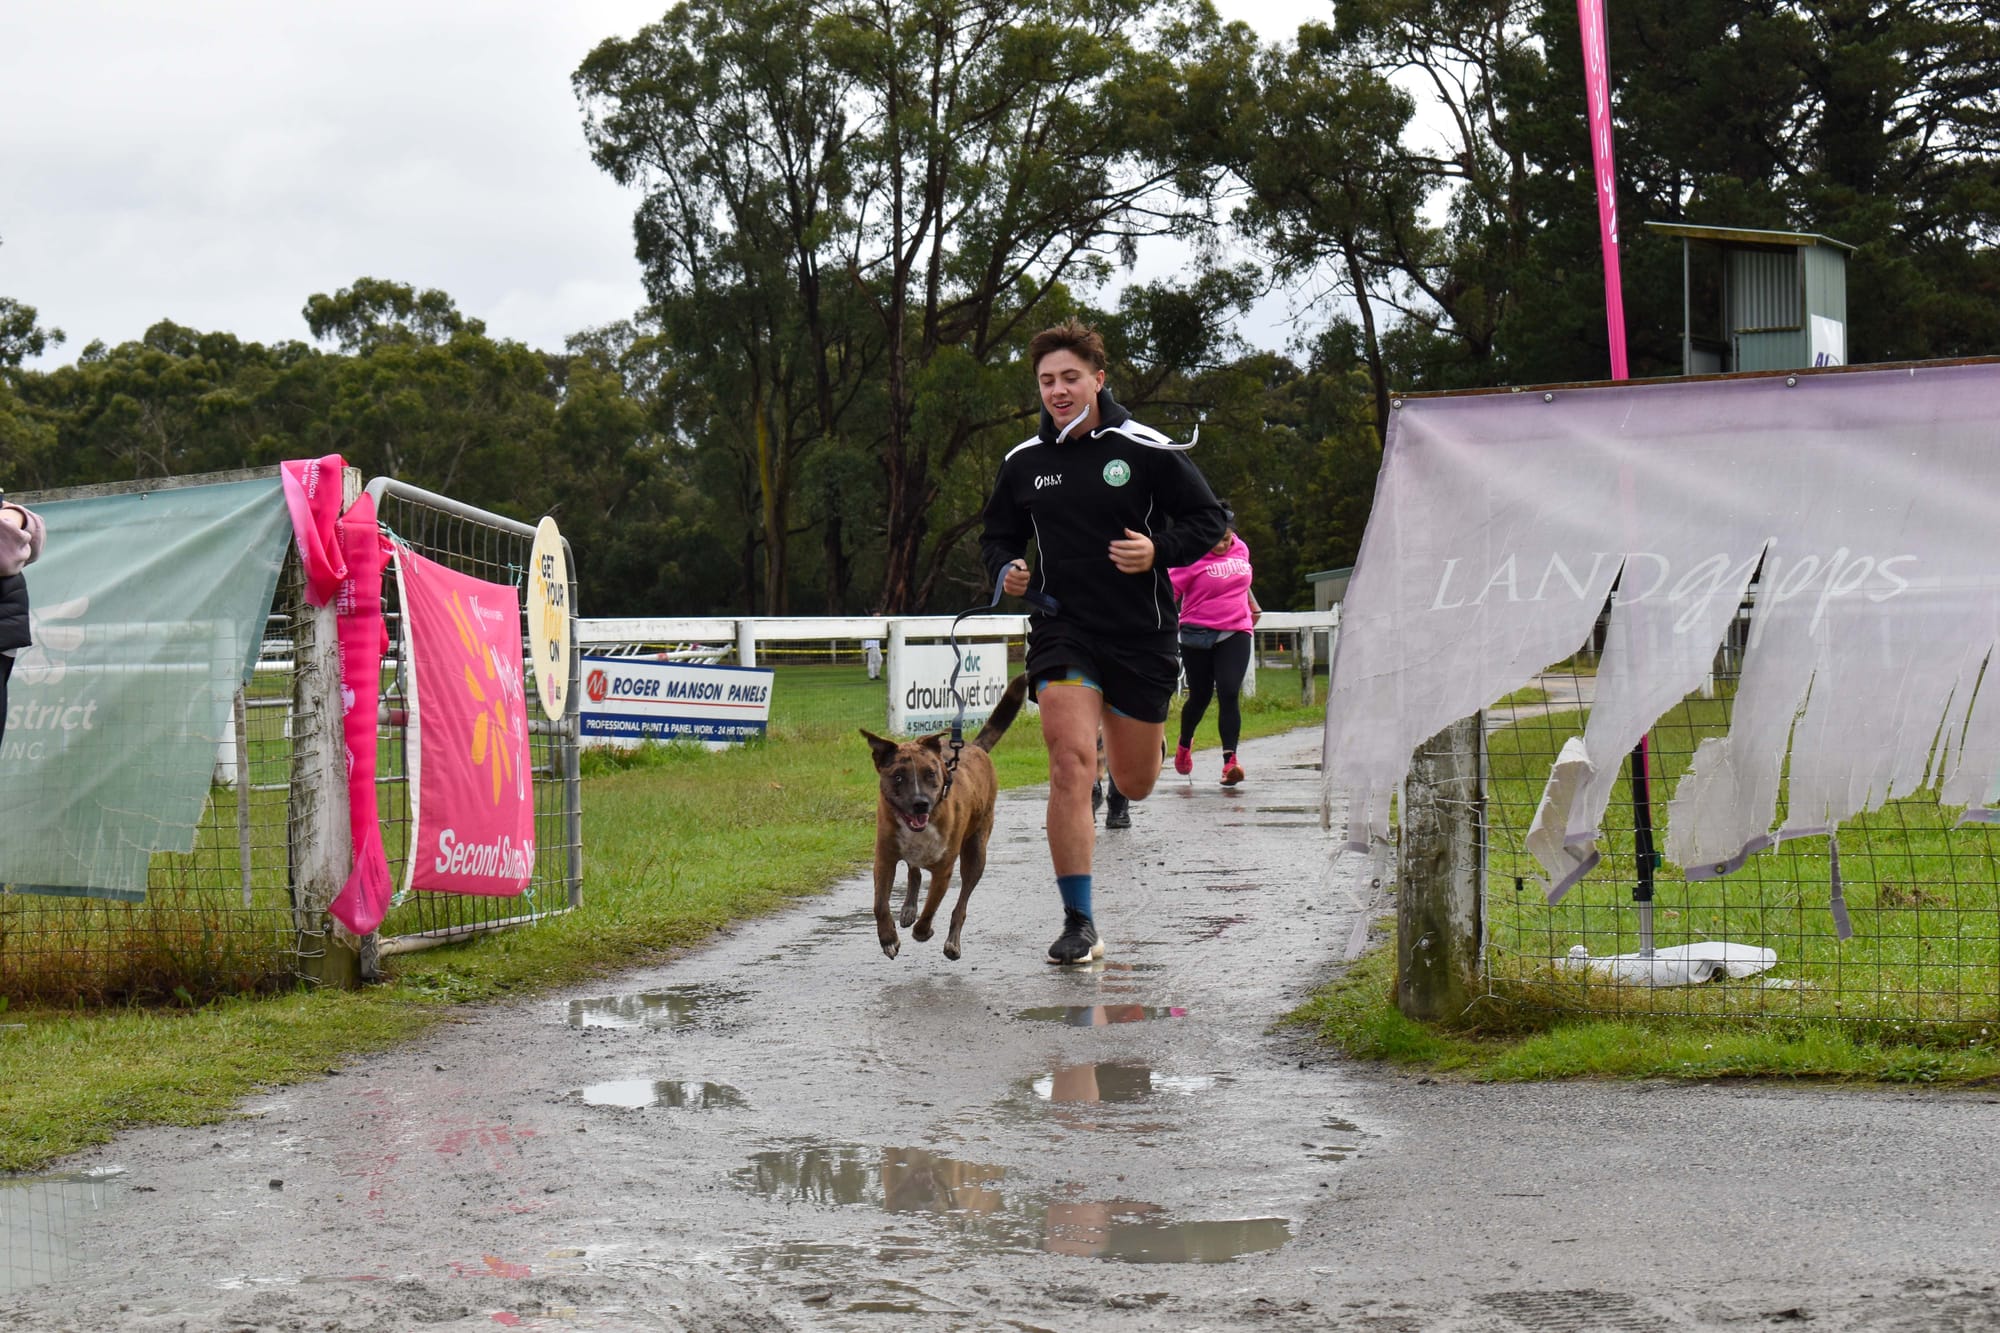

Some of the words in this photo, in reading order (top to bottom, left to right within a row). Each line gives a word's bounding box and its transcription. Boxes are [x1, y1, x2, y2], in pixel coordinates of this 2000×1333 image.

[541, 553, 555, 579] GET
[546, 583, 564, 607] YOUR
[550, 640, 560, 662] ON
[964, 650, 981, 673] dvc
[612, 677, 660, 697] ROGER
[666, 681, 723, 701] MANSON
[727, 684, 768, 703] PANELS
[906, 679, 956, 710] drouin
[961, 680, 980, 707] vet
[6, 697, 98, 730] strict
[906, 722, 912, 732] 4
[913, 720, 943, 732] SINCLAIR
[586, 719, 640, 732] PROFESSIONAL
[641, 722, 664, 733] PAINT
[664, 723, 670, 733] &
[670, 724, 693, 735] PANEL
[693, 725, 714, 735] WORK
[718, 726, 726, 736] 24
[726, 727, 736, 736] HR
[435, 828, 502, 877] Second
